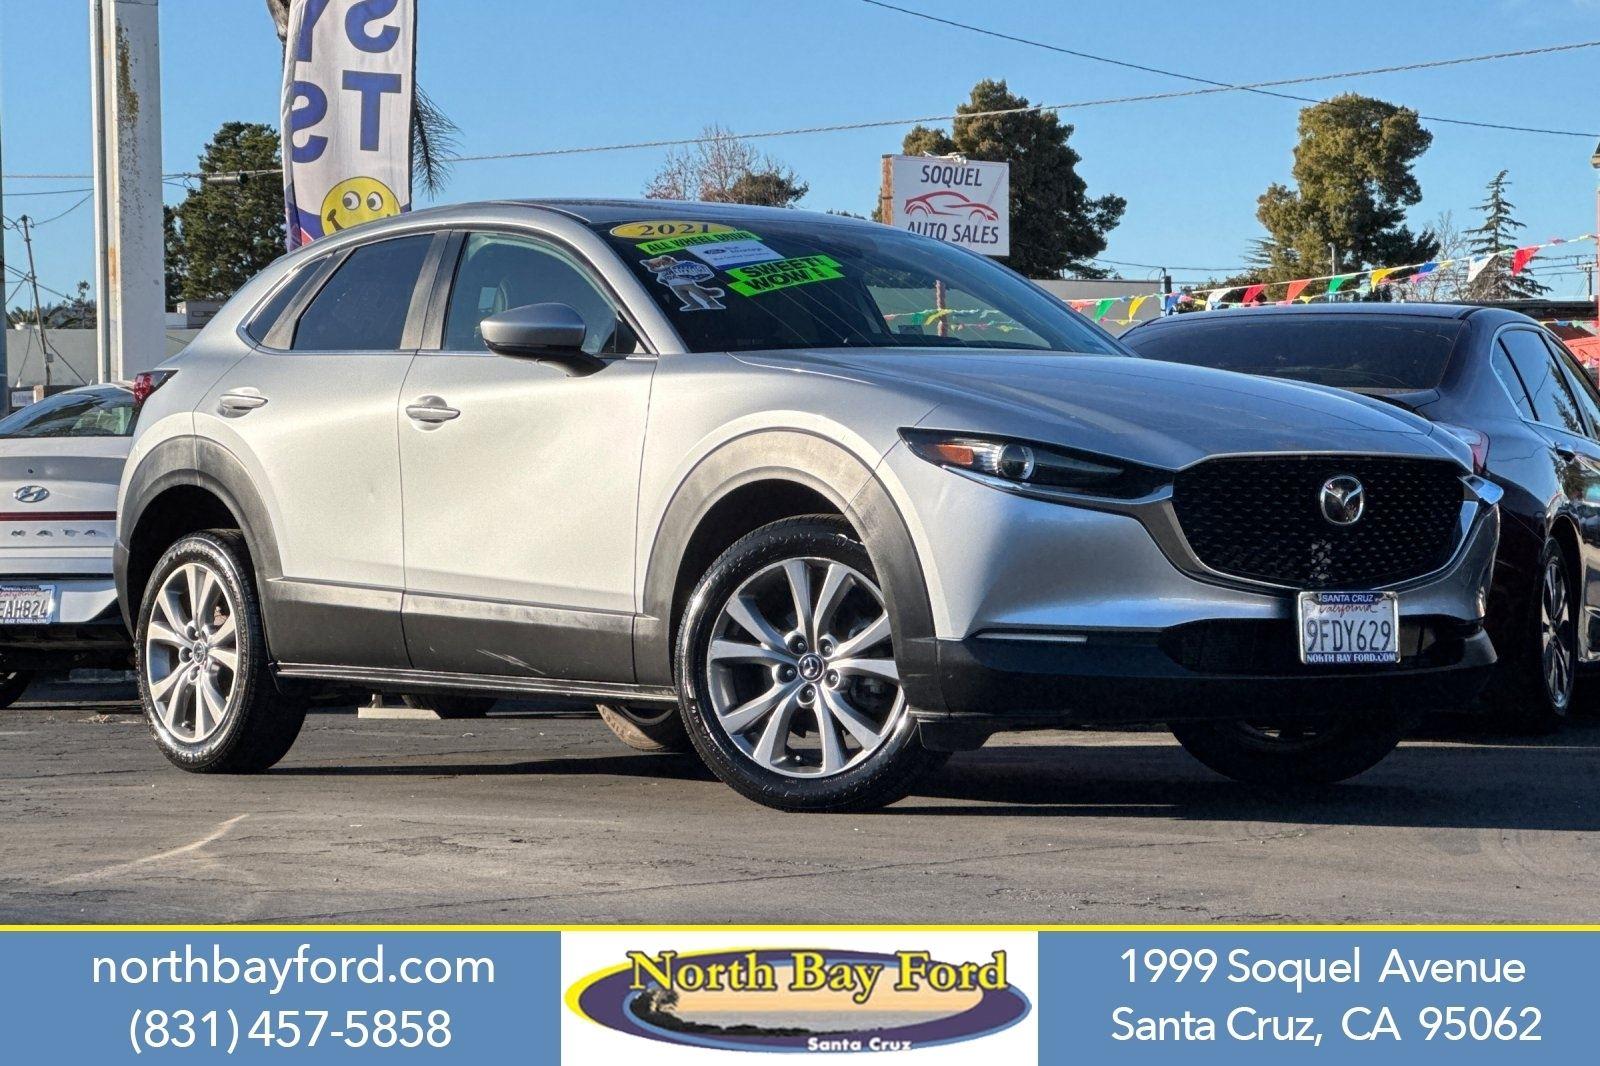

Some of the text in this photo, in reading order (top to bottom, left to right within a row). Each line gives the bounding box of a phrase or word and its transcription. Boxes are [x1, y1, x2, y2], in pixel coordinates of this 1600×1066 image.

[920, 164, 983, 188] SOQUEL
[639, 223, 709, 236] 2021
[907, 221, 999, 245] AUTO SALES
[645, 230, 753, 252] ALL WHEEL DRIVE
[1322, 594, 1374, 602] SANTA CRUZ
[1307, 619, 1391, 652] 9FDY629
[1306, 653, 1396, 662] NORTH BAY FORD.COM
